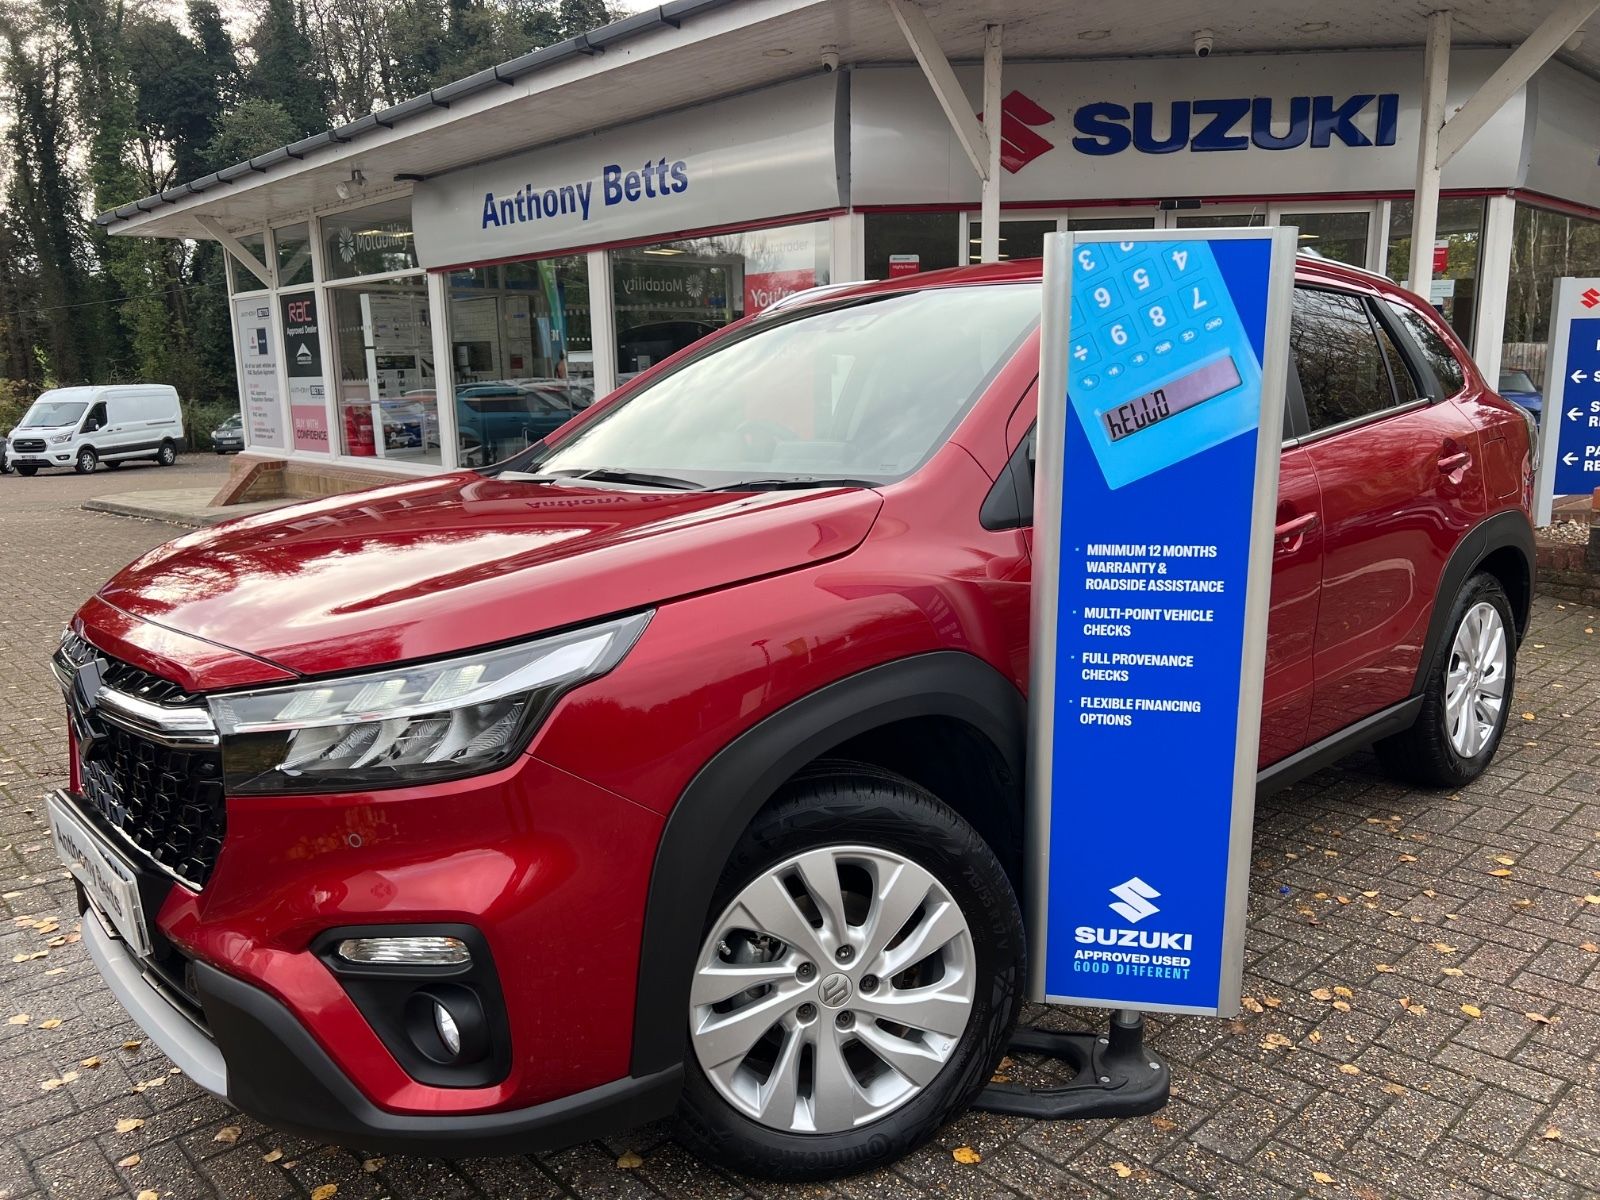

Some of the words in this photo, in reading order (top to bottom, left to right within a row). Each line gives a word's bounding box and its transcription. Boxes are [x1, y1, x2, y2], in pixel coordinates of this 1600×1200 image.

[1072, 93, 1400, 156] SUZUKI
[482, 181, 593, 230] Anthony
[603, 157, 688, 207] Betts
[1171, 250, 1189, 271] 4
[1132, 268, 1150, 291] 5
[1191, 287, 1207, 310] 7
[1148, 306, 1167, 327] 8
[296, 429, 328, 440] CONFIDENCE
[1087, 543, 1147, 557] MINIMUM
[1148, 544, 1162, 557] 12
[1163, 545, 1218, 558] MONTHS
[1086, 561, 1156, 574] WARRANTY
[1157, 562, 1168, 575] &
[1085, 578, 1147, 592] ROADSIDE
[1148, 580, 1225, 593] ASSISTANCE
[1084, 607, 1162, 621] MULTI-POINT
[1163, 609, 1214, 622] VEHICLE
[1083, 624, 1132, 637] CHECKS
[1082, 652, 1111, 665] FULL
[1112, 653, 1194, 667] PROVENANCE
[1081, 668, 1129, 682] CHECKS
[1080, 697, 1134, 711] FLEXIBLE
[1135, 699, 1201, 713] FINANCING
[1079, 713, 1132, 727] OPTIONS
[1074, 926, 1193, 951] SUZUKI
[1074, 949, 1151, 964] APPROVED
[1152, 954, 1191, 967] USED
[1073, 960, 1109, 974] GOOD
[1116, 964, 1191, 980] DIFFERENT
